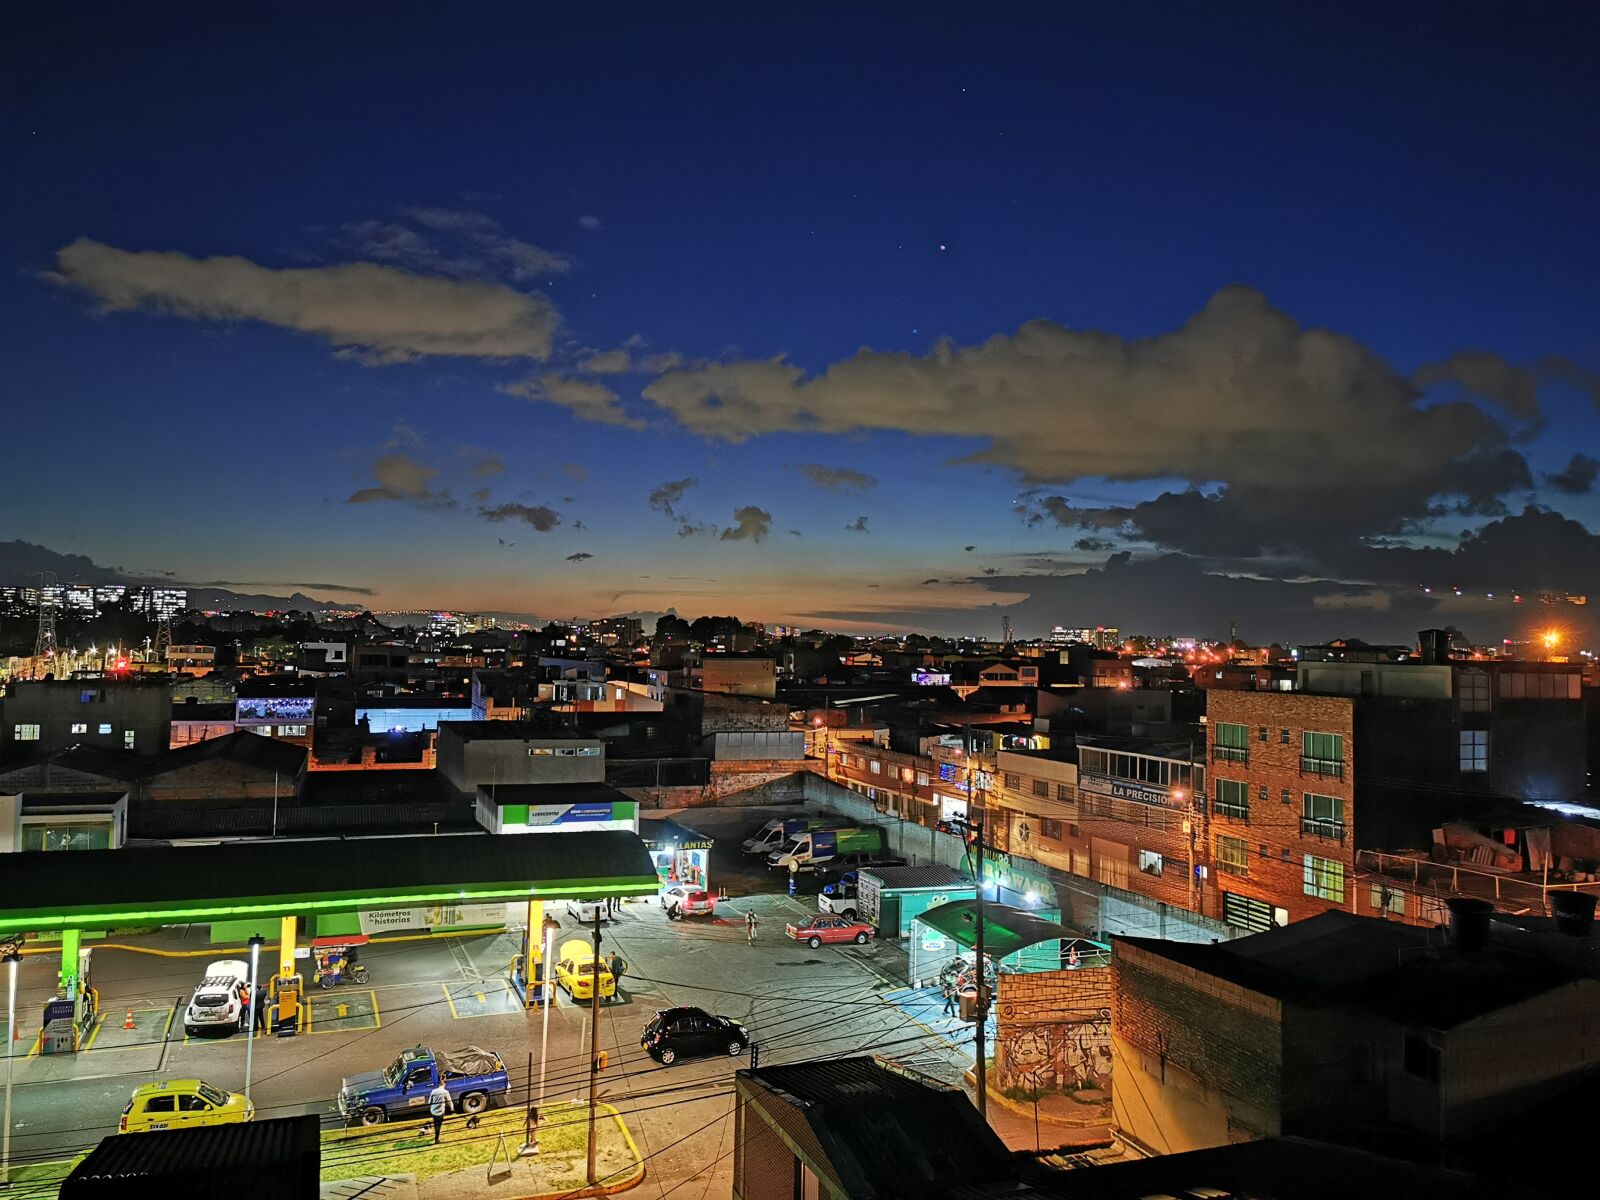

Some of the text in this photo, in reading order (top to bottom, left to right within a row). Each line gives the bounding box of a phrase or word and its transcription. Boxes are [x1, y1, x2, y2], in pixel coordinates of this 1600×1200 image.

[1113, 785, 1125, 797] LA
[369, 910, 411, 919] Kilómetros
[374, 916, 411, 925] historias
